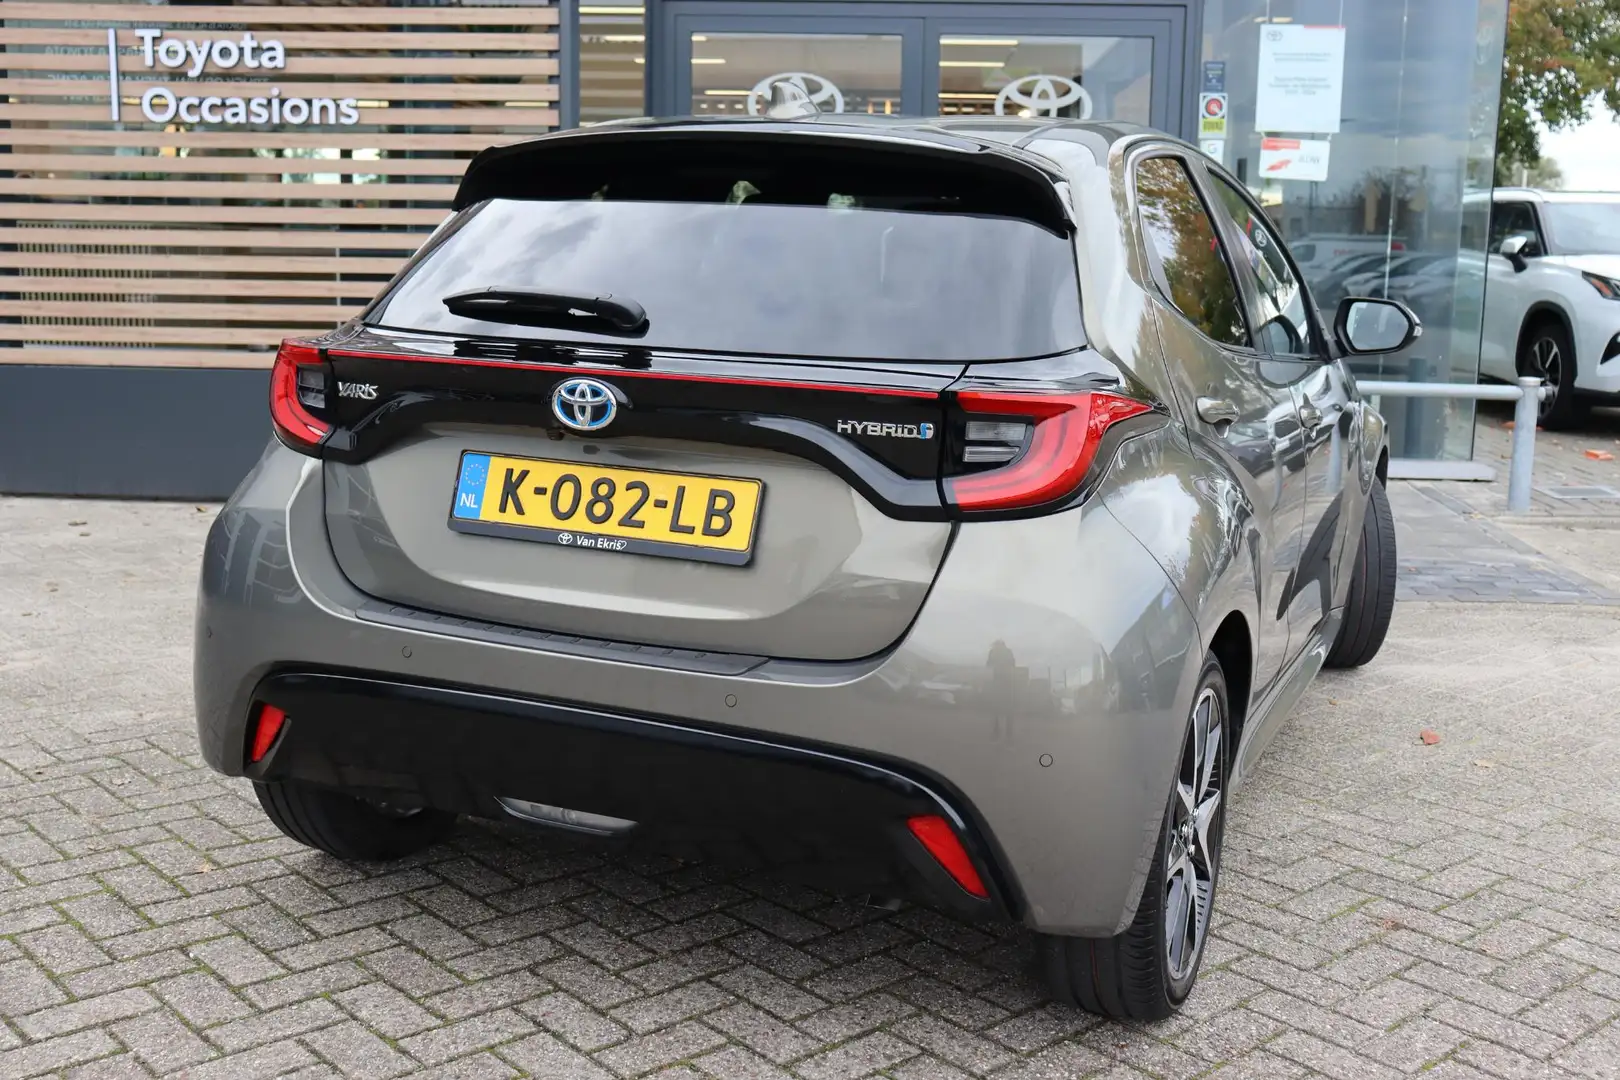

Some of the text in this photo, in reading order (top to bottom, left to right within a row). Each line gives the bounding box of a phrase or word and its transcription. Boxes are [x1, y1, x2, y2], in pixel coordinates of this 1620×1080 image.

[134, 28, 286, 78] Toyota
[141, 86, 360, 125] Occasions
[337, 381, 379, 400] YARIS
[837, 419, 921, 439] HYBRID
[459, 493, 479, 509] NL
[498, 467, 736, 538] K-082-LB
[576, 535, 622, 551] Van Ekris
